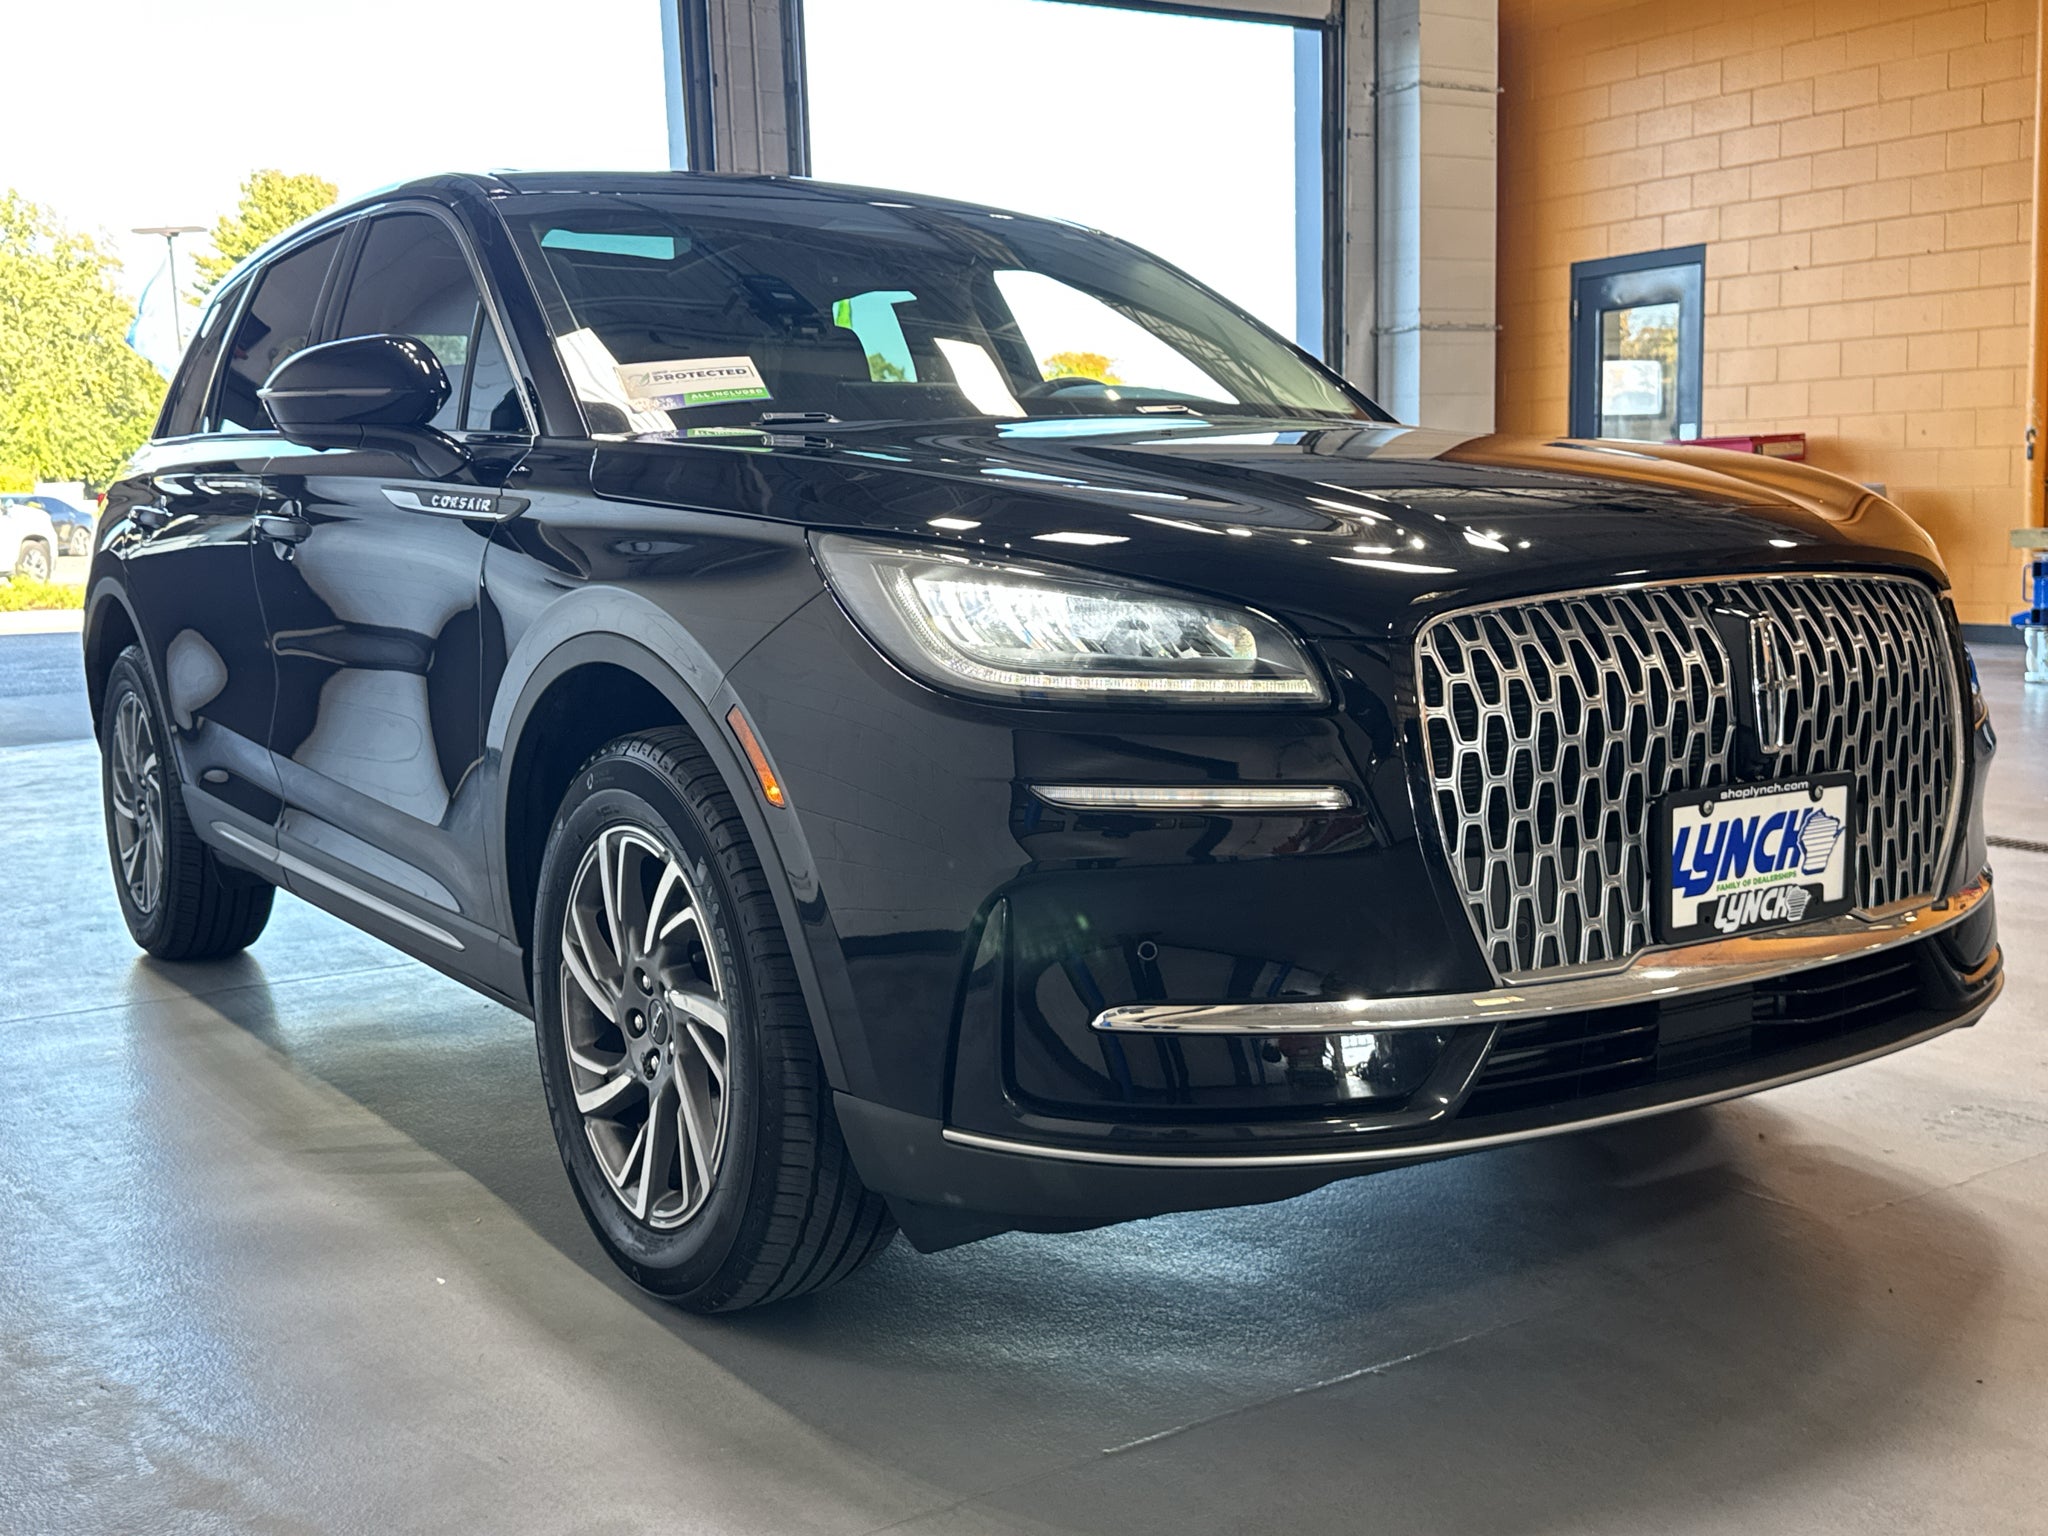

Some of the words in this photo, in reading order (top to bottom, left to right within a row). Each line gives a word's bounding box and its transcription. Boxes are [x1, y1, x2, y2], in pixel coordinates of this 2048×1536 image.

[653, 368, 747, 382] PROTECTED
[691, 392, 710, 400] ALL
[711, 388, 763, 397] INCLUDED
[431, 494, 492, 512] CORSAIR
[1720, 780, 1809, 800] shoplynch.com
[1672, 807, 1814, 898] LYNCH
[1716, 881, 1741, 892] FAMILY
[1742, 878, 1752, 888] OF
[1753, 870, 1797, 885] DEALERSHIPS
[1713, 885, 1793, 933] LYNCH
